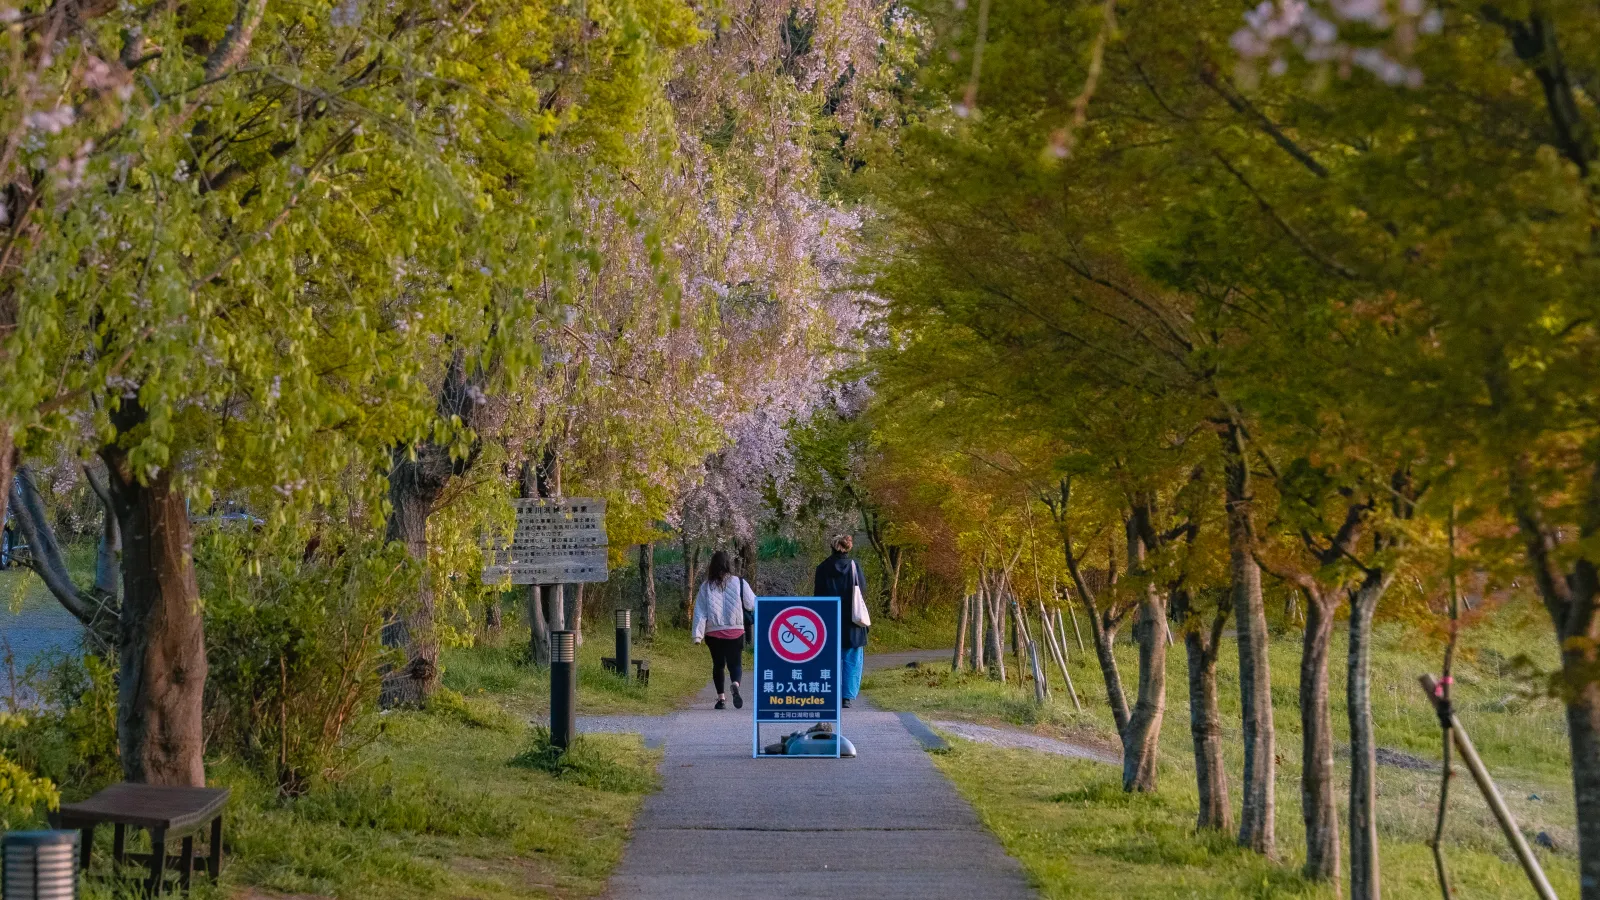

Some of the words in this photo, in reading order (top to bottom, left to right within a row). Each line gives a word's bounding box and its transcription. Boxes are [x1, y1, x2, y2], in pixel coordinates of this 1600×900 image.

[763, 669, 831, 680] 自転車
[763, 682, 832, 693] 乗り入れ禁止
[769, 696, 784, 705] No
[785, 696, 825, 706] Bicycles
